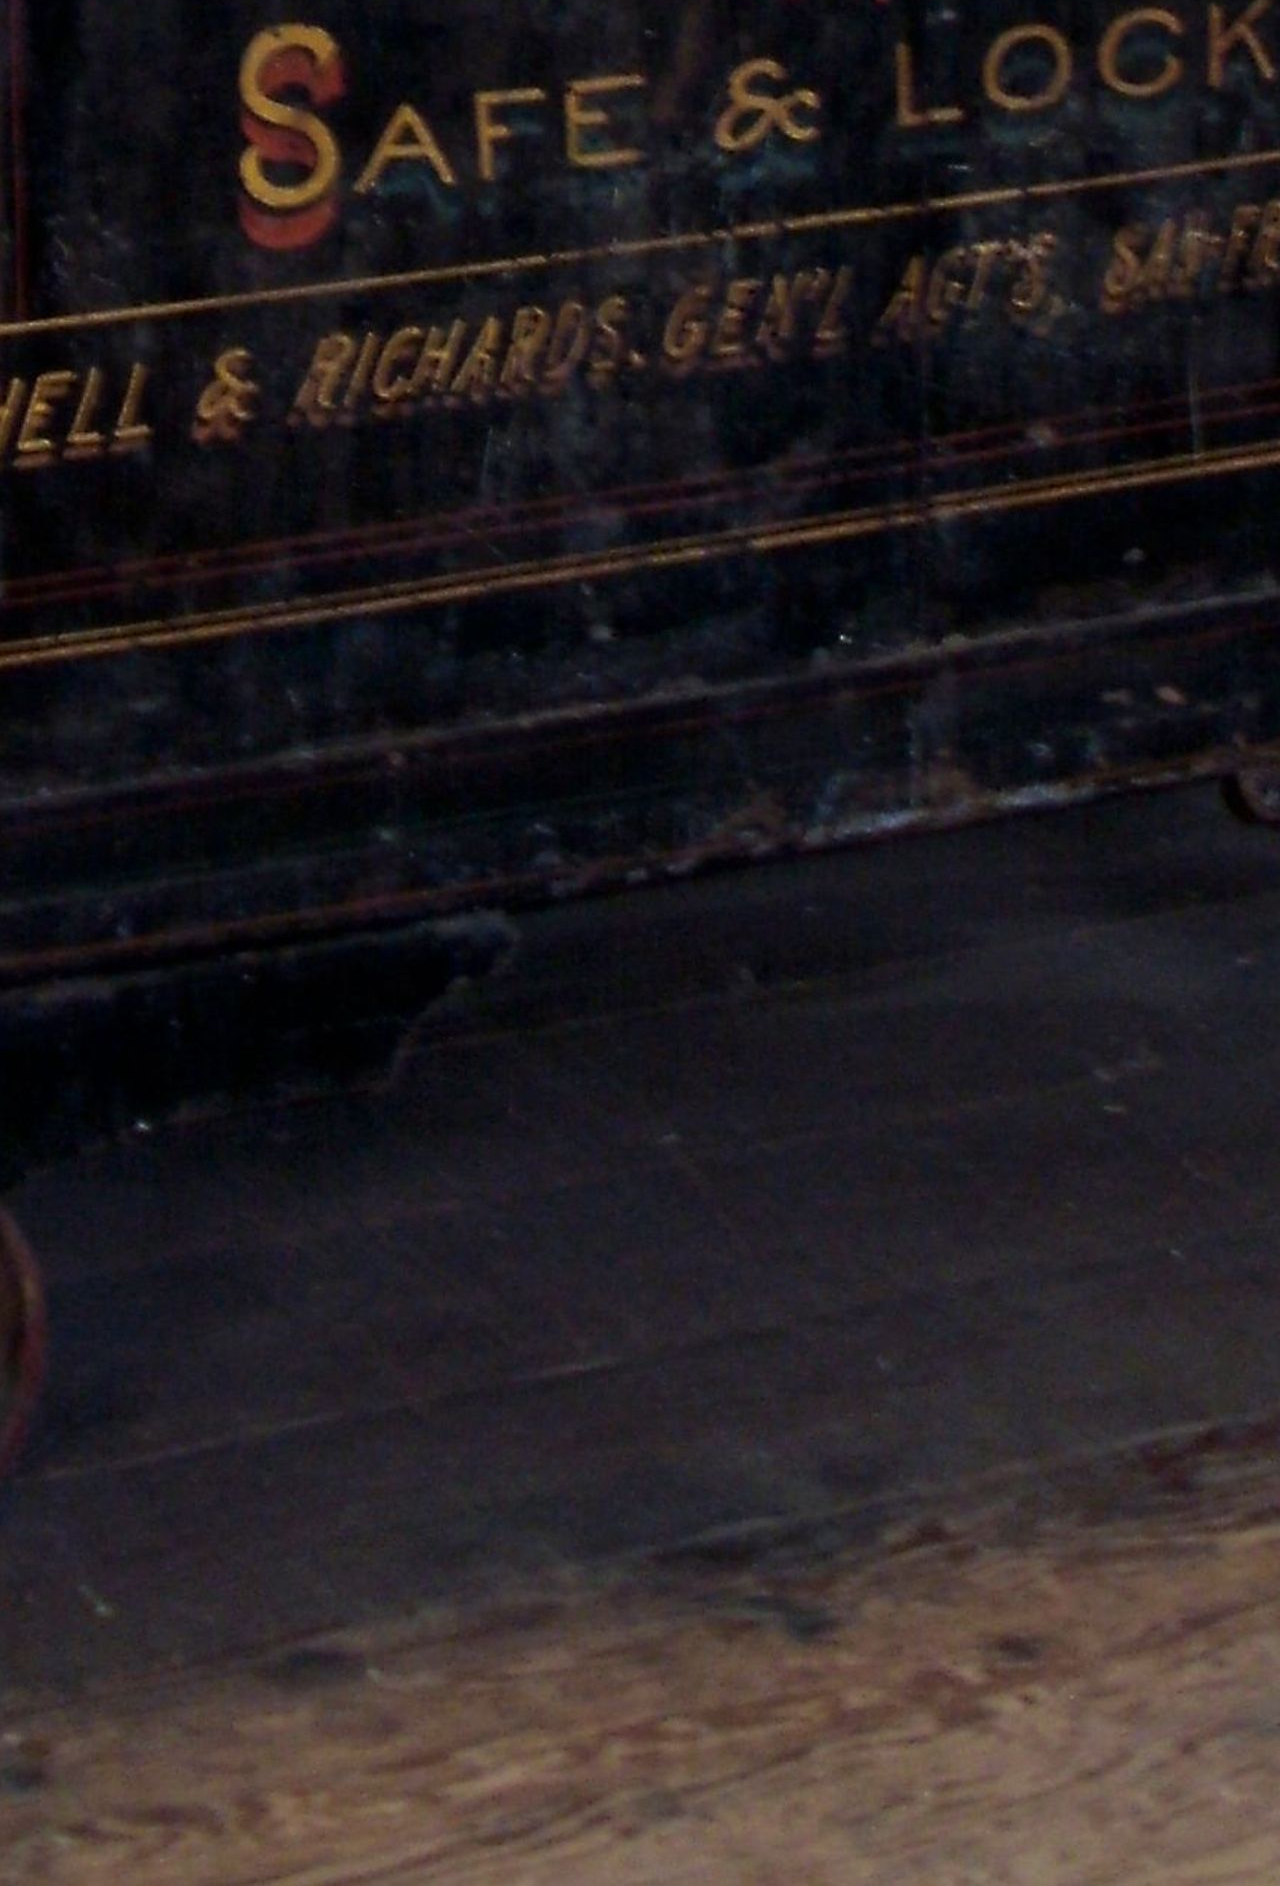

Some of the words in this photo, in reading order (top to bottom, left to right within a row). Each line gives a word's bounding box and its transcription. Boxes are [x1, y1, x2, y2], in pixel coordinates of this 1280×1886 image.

[238, 25, 648, 234] SAFE
[717, 59, 823, 151] &
[192, 347, 260, 437] &
